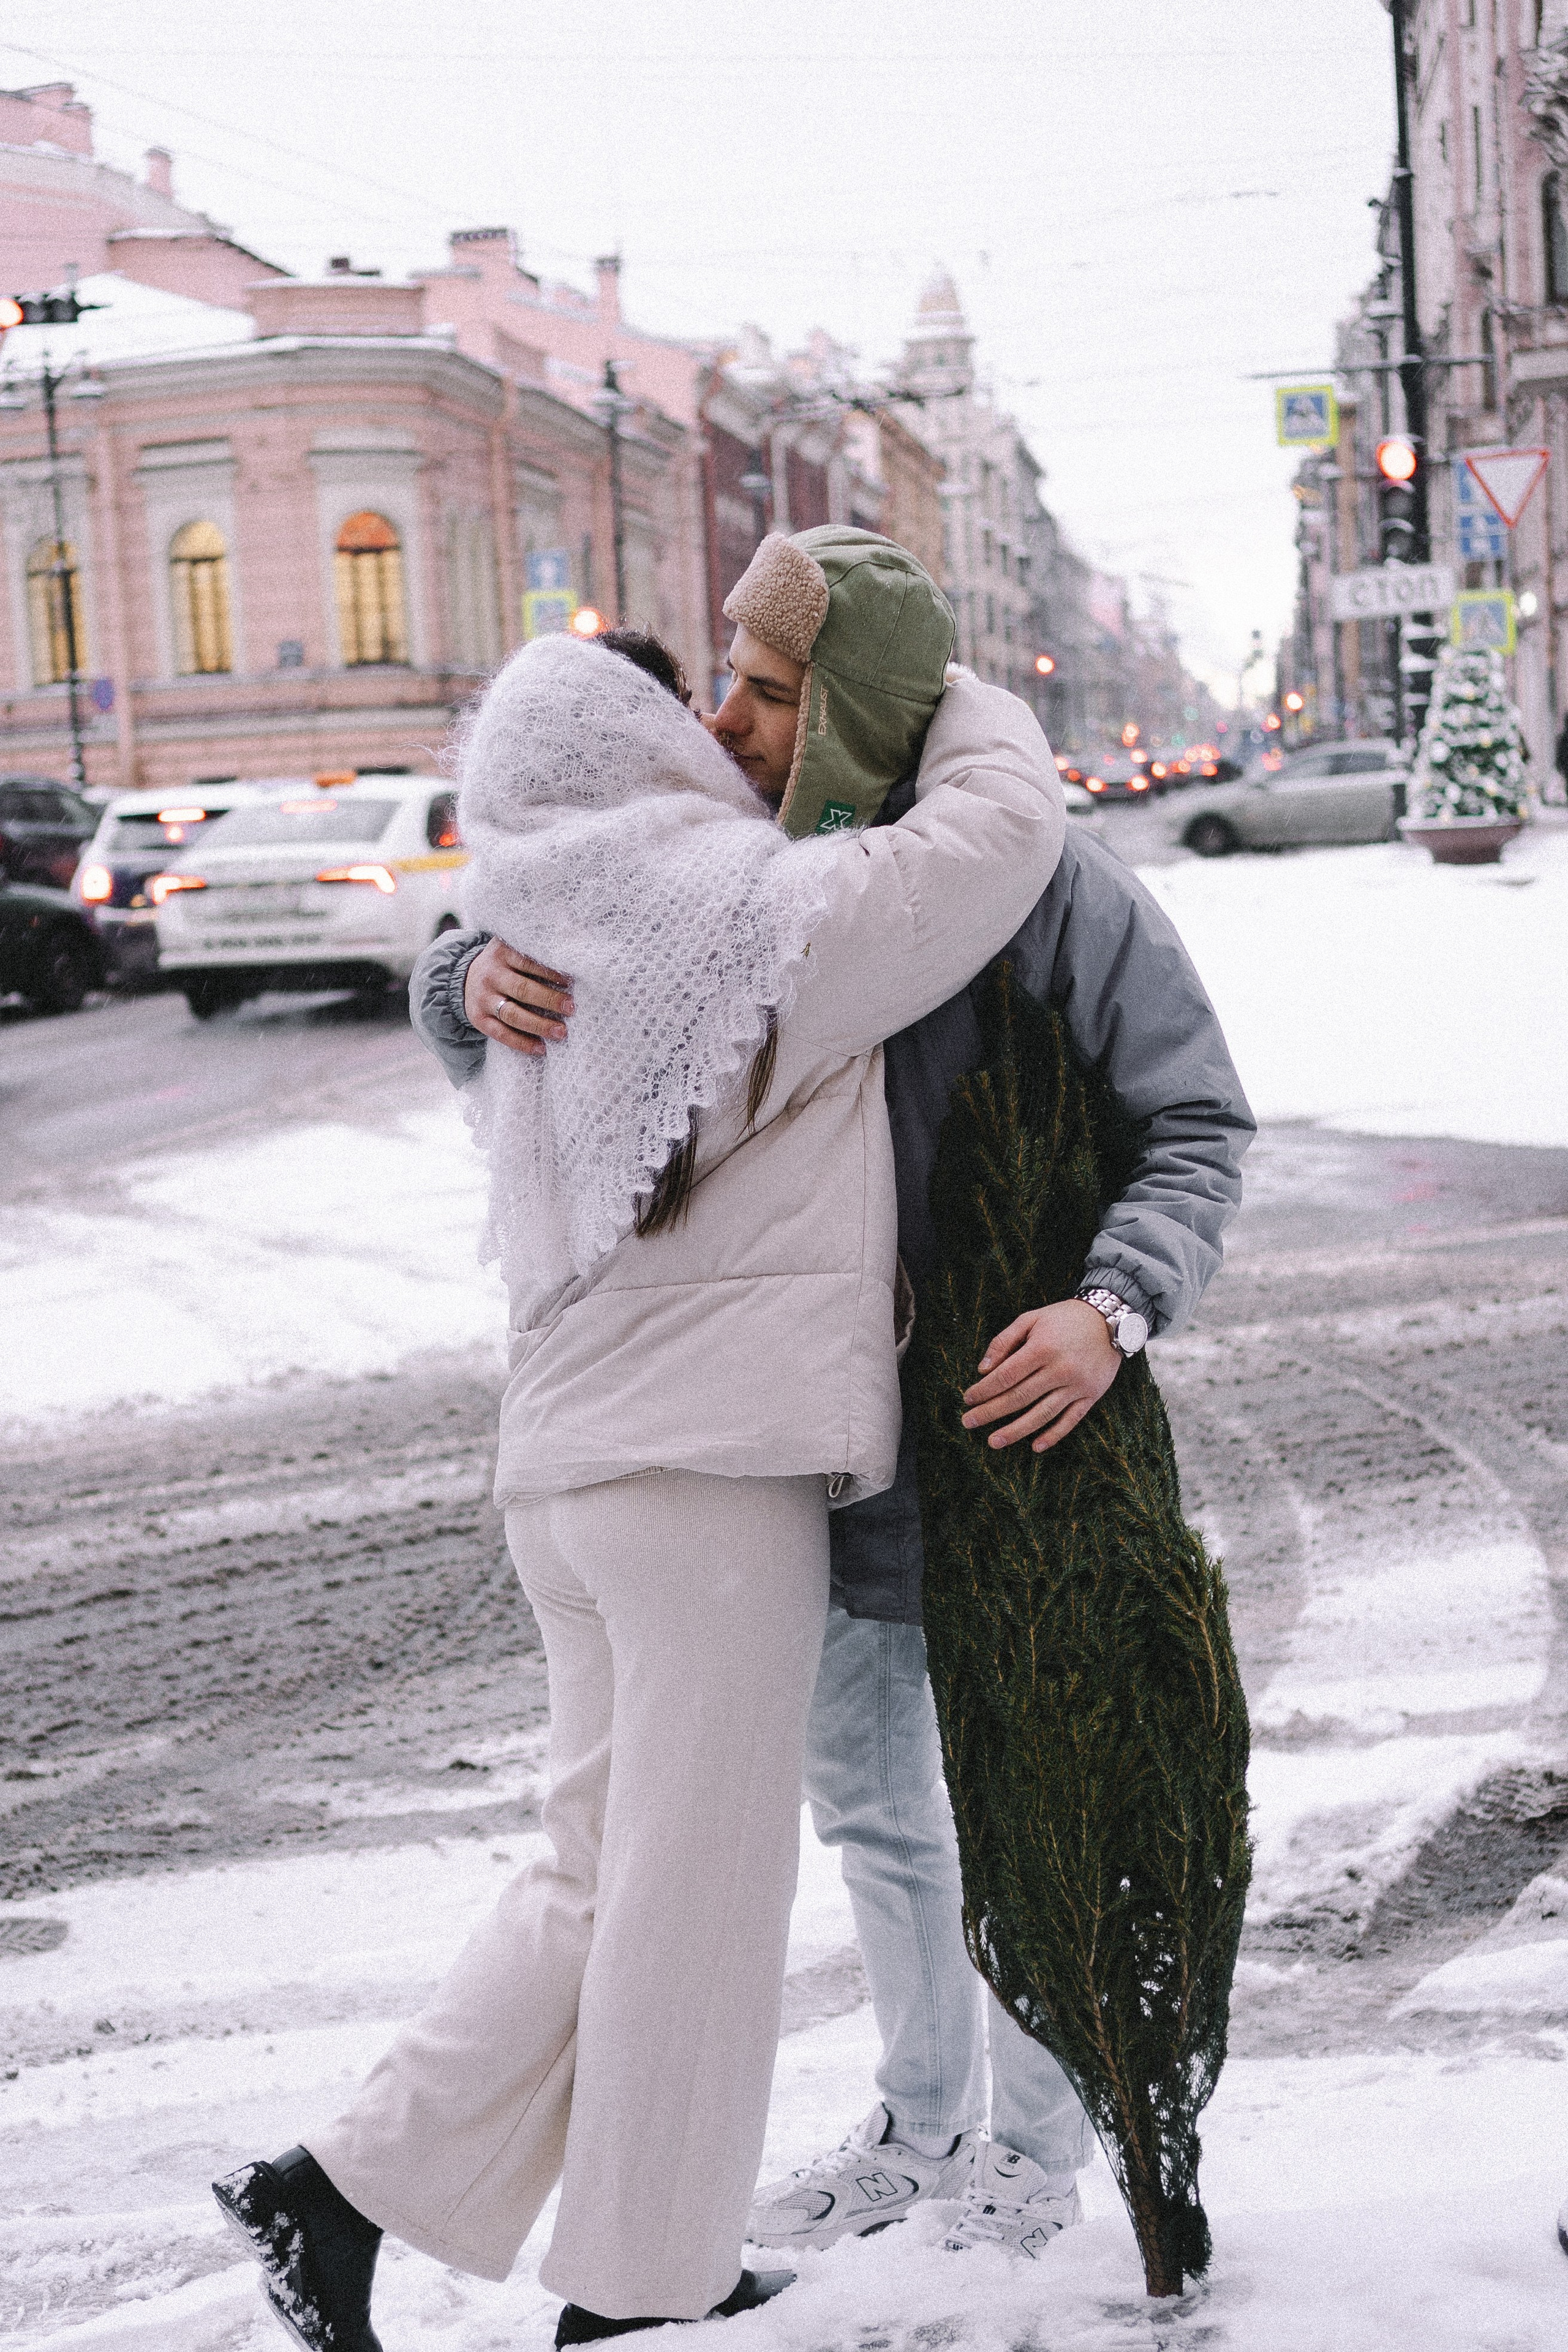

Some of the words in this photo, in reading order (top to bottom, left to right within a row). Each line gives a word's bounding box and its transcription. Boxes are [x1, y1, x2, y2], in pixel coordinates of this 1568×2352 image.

[1349, 575, 1439, 607] СТОП
[818, 684, 828, 736] EXHAUST
[856, 2172, 898, 2202] N
